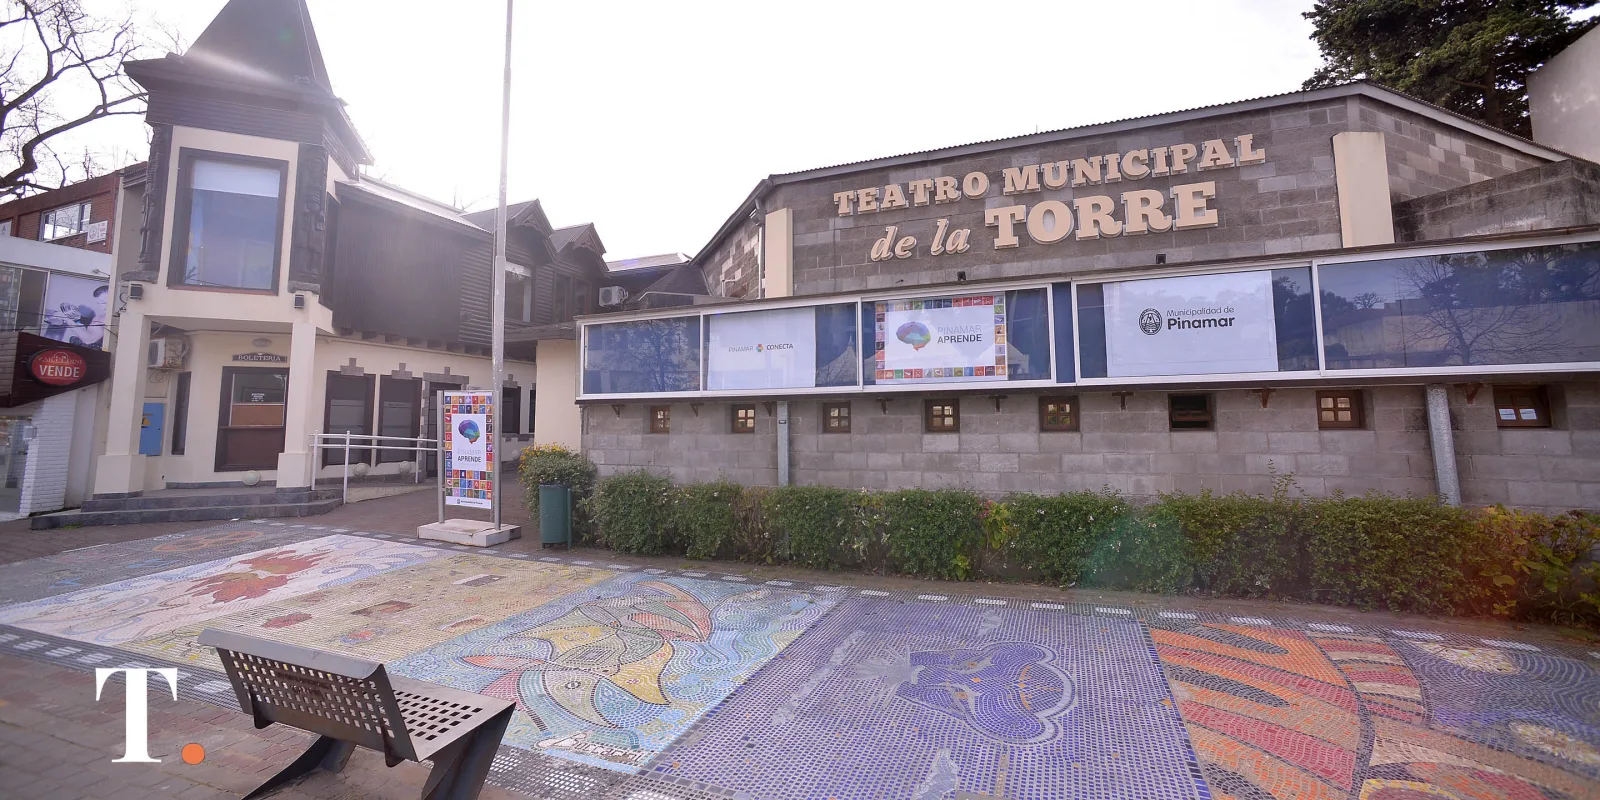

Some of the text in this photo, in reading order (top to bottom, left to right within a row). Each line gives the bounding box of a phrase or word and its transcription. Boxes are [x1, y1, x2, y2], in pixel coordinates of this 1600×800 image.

[833, 133, 1266, 216] TEATRO MUNICIPAL
[870, 181, 1219, 262] de la TORRE
[1167, 306, 1235, 317] Municipalidad de
[1167, 317, 1235, 330] Pinamar
[937, 325, 982, 335] PINAMAR
[937, 334, 982, 344] APRENDE
[40, 364, 80, 378] VENDE
[457, 455, 482, 463] APRENDE
